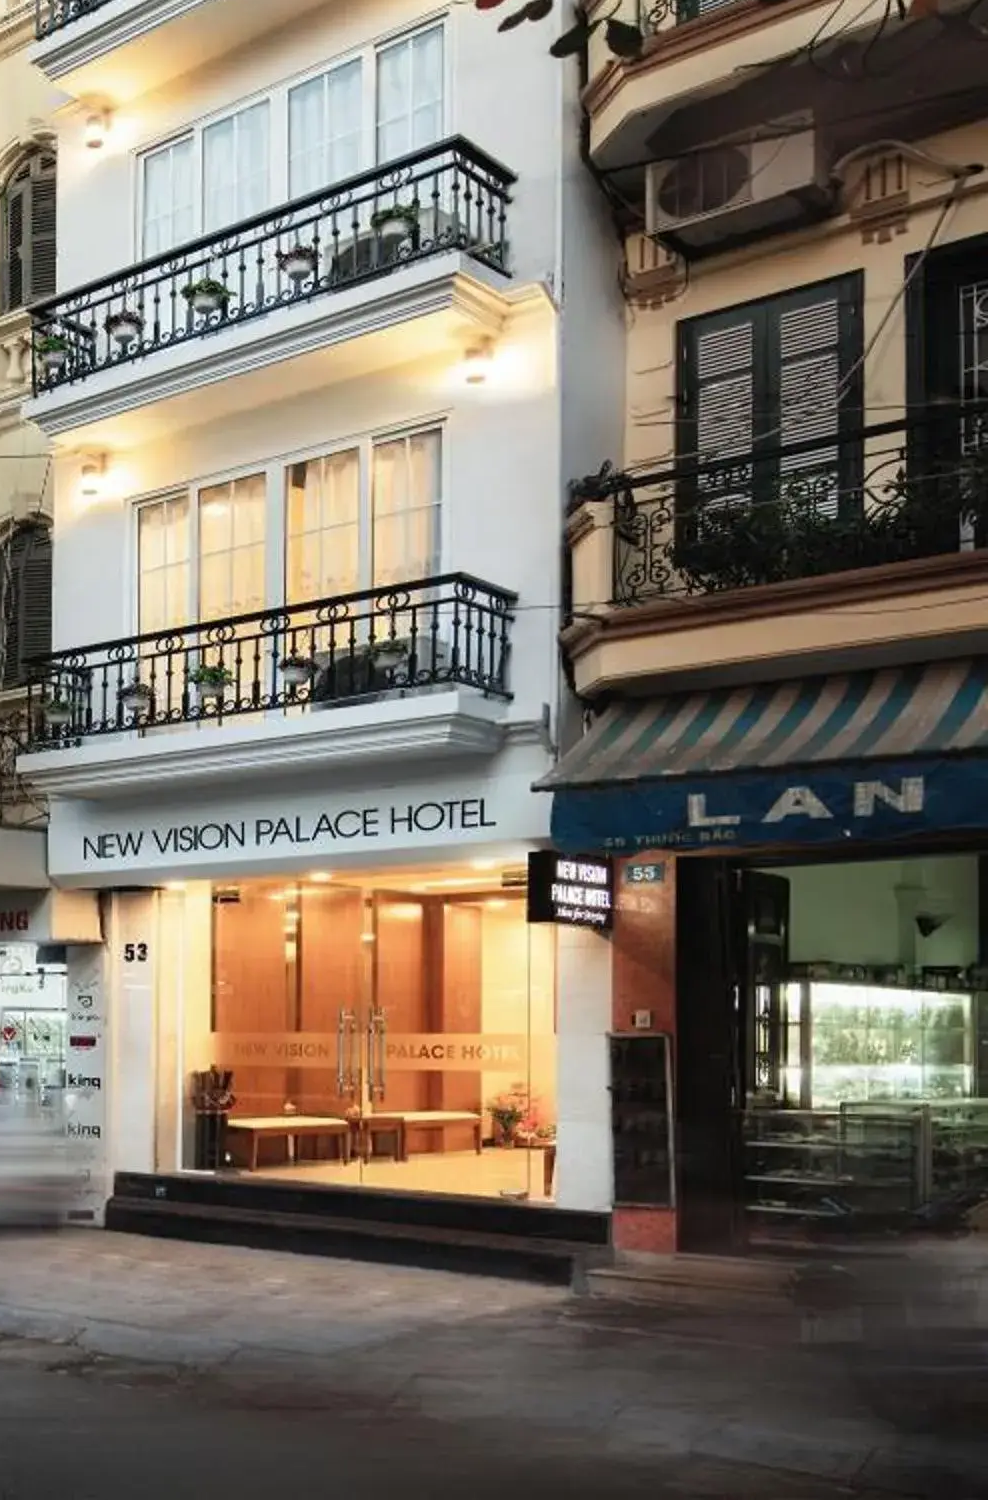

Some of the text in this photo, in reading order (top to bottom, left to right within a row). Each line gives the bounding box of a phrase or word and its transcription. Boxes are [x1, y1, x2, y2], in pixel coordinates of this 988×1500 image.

[687, 776, 924, 827] LAN
[83, 798, 497, 860] NEW VISION PALACE HOTEL
[124, 943, 148, 963] 53
[274, 1042, 330, 1058] VISION
[387, 1043, 455, 1060] PALACE
